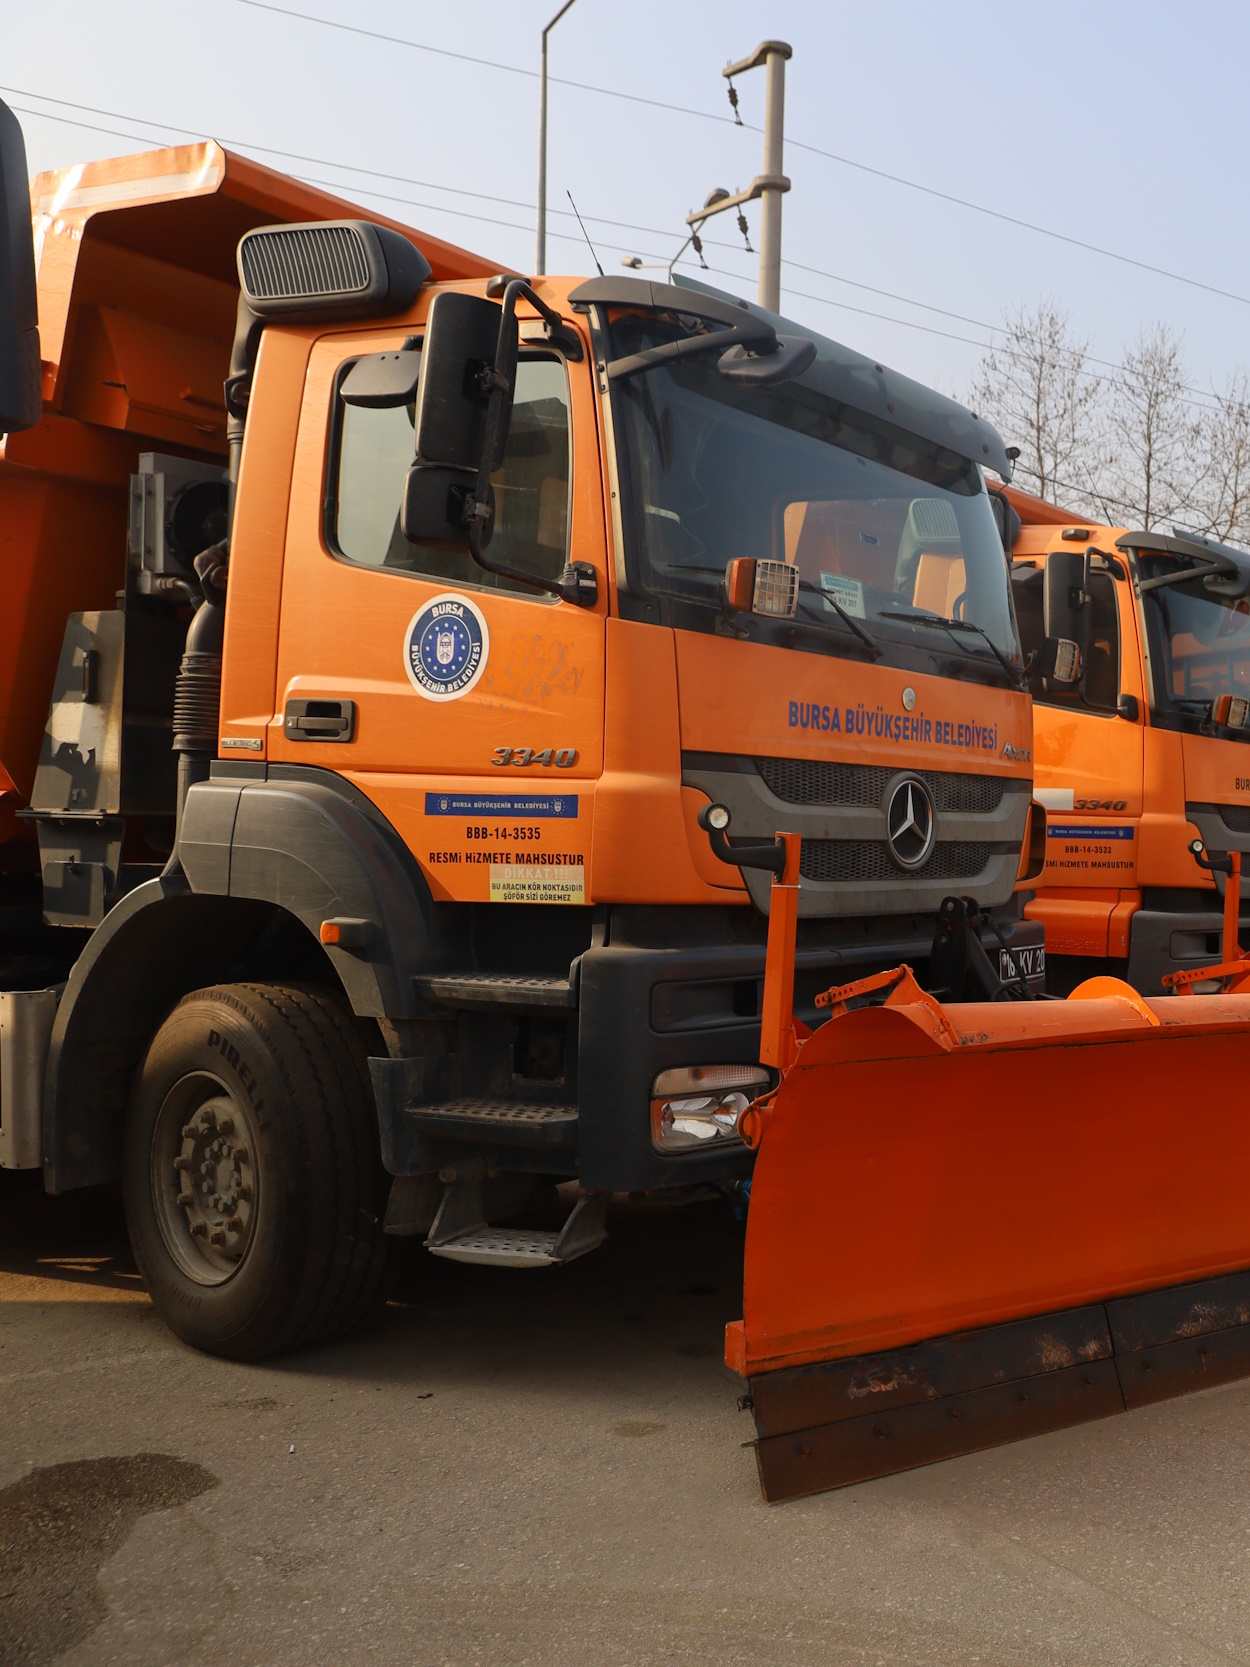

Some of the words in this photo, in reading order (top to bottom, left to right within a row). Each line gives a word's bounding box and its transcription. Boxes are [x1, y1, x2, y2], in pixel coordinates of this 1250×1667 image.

[431, 603, 464, 617] BURSA
[411, 645, 446, 693] BÜYÜKŞEHİR
[447, 642, 481, 692] BELEDİYESİ
[788, 701, 841, 733] BURSA
[845, 703, 932, 743] BÜYÜKŞEHİR
[935, 719, 998, 750] BELEDİYESİ
[490, 747, 577, 768] 3340
[474, 800, 512, 810] BÜYÜKŞEHİR
[513, 801, 549, 810] BELEDİYESİ
[1074, 798, 1127, 811] 3340
[466, 826, 541, 840] BBB-14-3535
[1065, 846, 1112, 854] BBB-14-3532
[515, 853, 584, 865] MAHSUSTUR
[1091, 861, 1134, 869] MAHSUSTUR
[504, 866, 550, 879] DİKKAT
[502, 883, 526, 891] ARACIN
[527, 882, 541, 891] KÖR
[542, 884, 583, 892] NOKTASIDIR
[503, 892, 524, 901] ŞÖFÖR
[525, 892, 538, 901] SİZİ
[539, 892, 571, 902] GÖREMEZ
[1019, 951, 1033, 975] KV
[207, 1029, 270, 1134] PIRELLI
